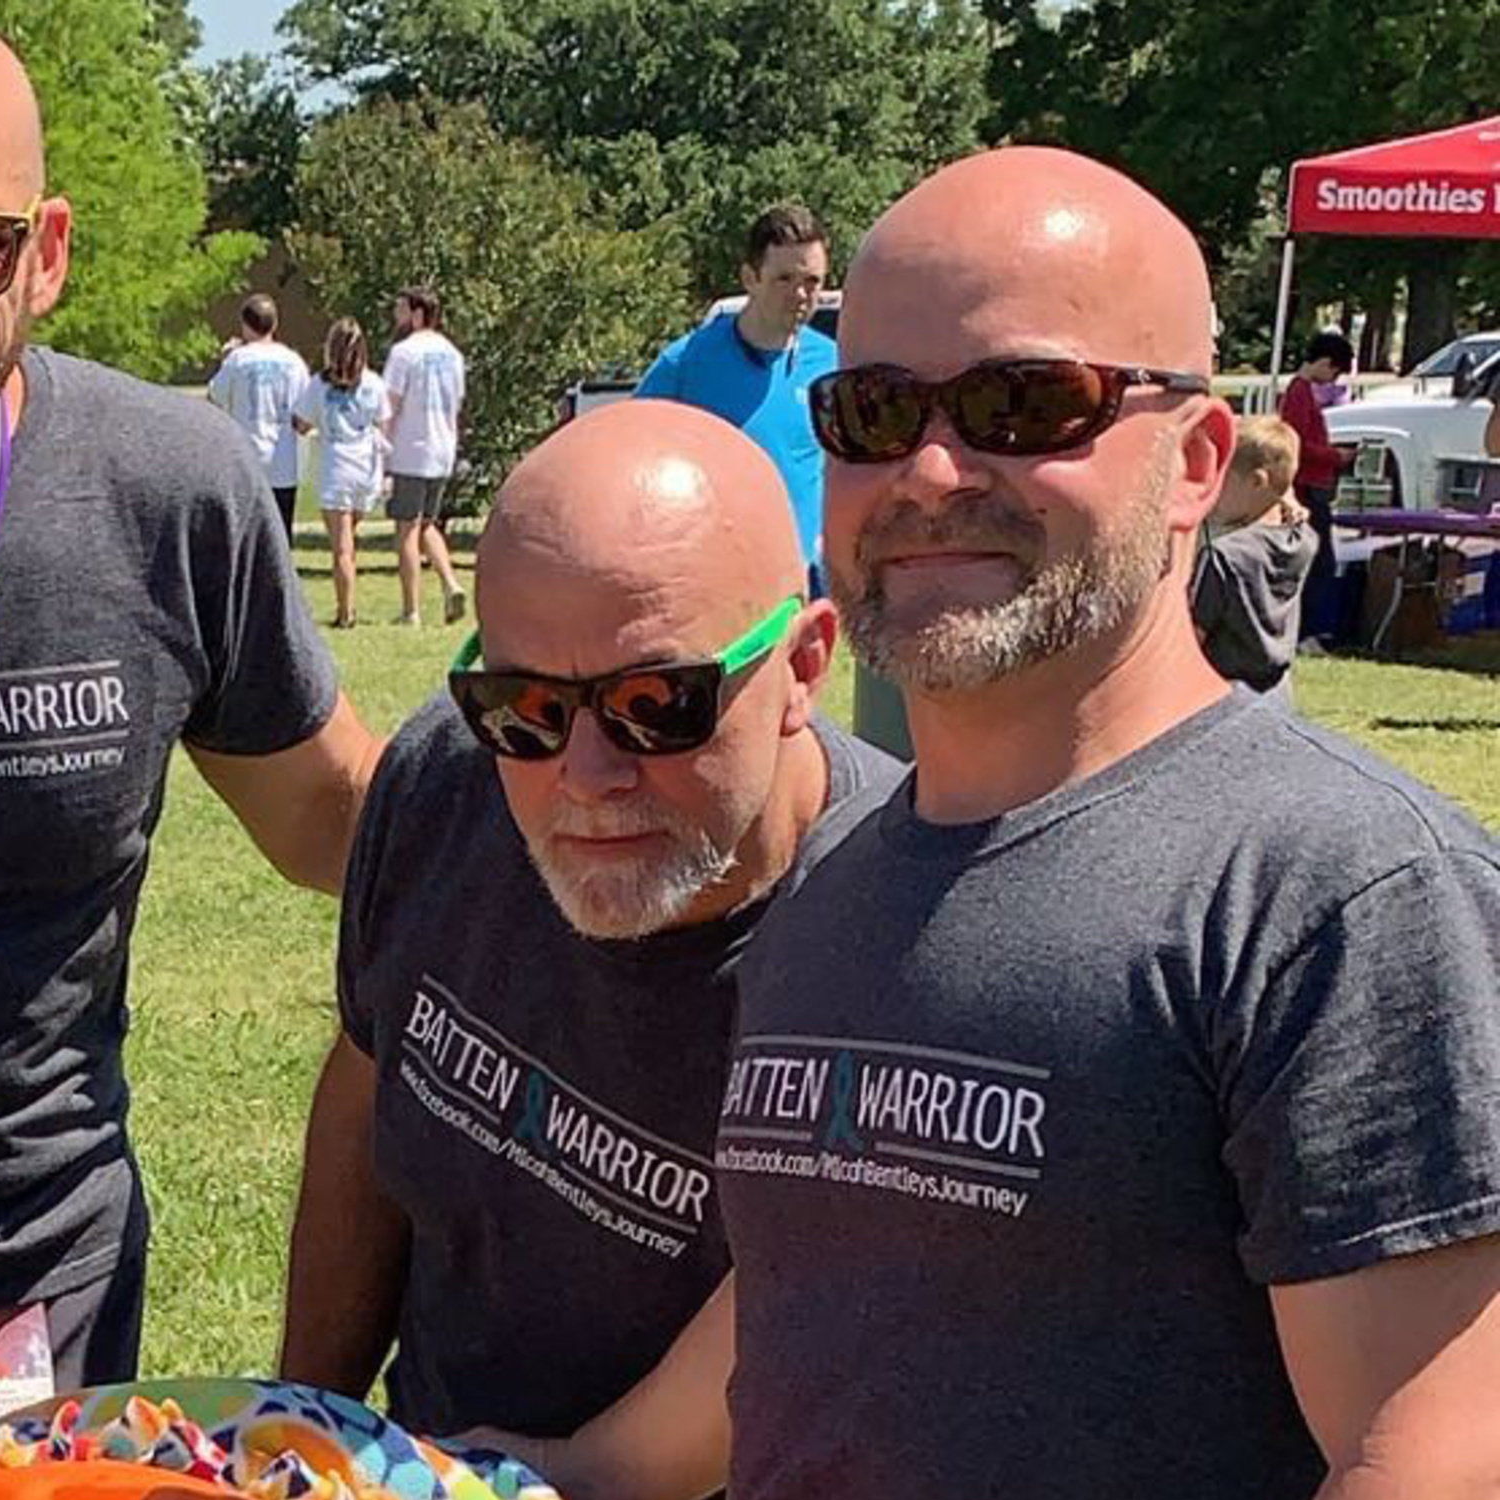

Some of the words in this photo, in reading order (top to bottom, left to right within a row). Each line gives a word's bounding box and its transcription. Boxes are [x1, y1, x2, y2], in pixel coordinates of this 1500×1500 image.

[1317, 178, 1486, 214] Smoothies
[405, 991, 520, 1111] BATTEN
[546, 1094, 710, 1222] WARRIOR
[857, 1064, 1046, 1158] WARRIOR
